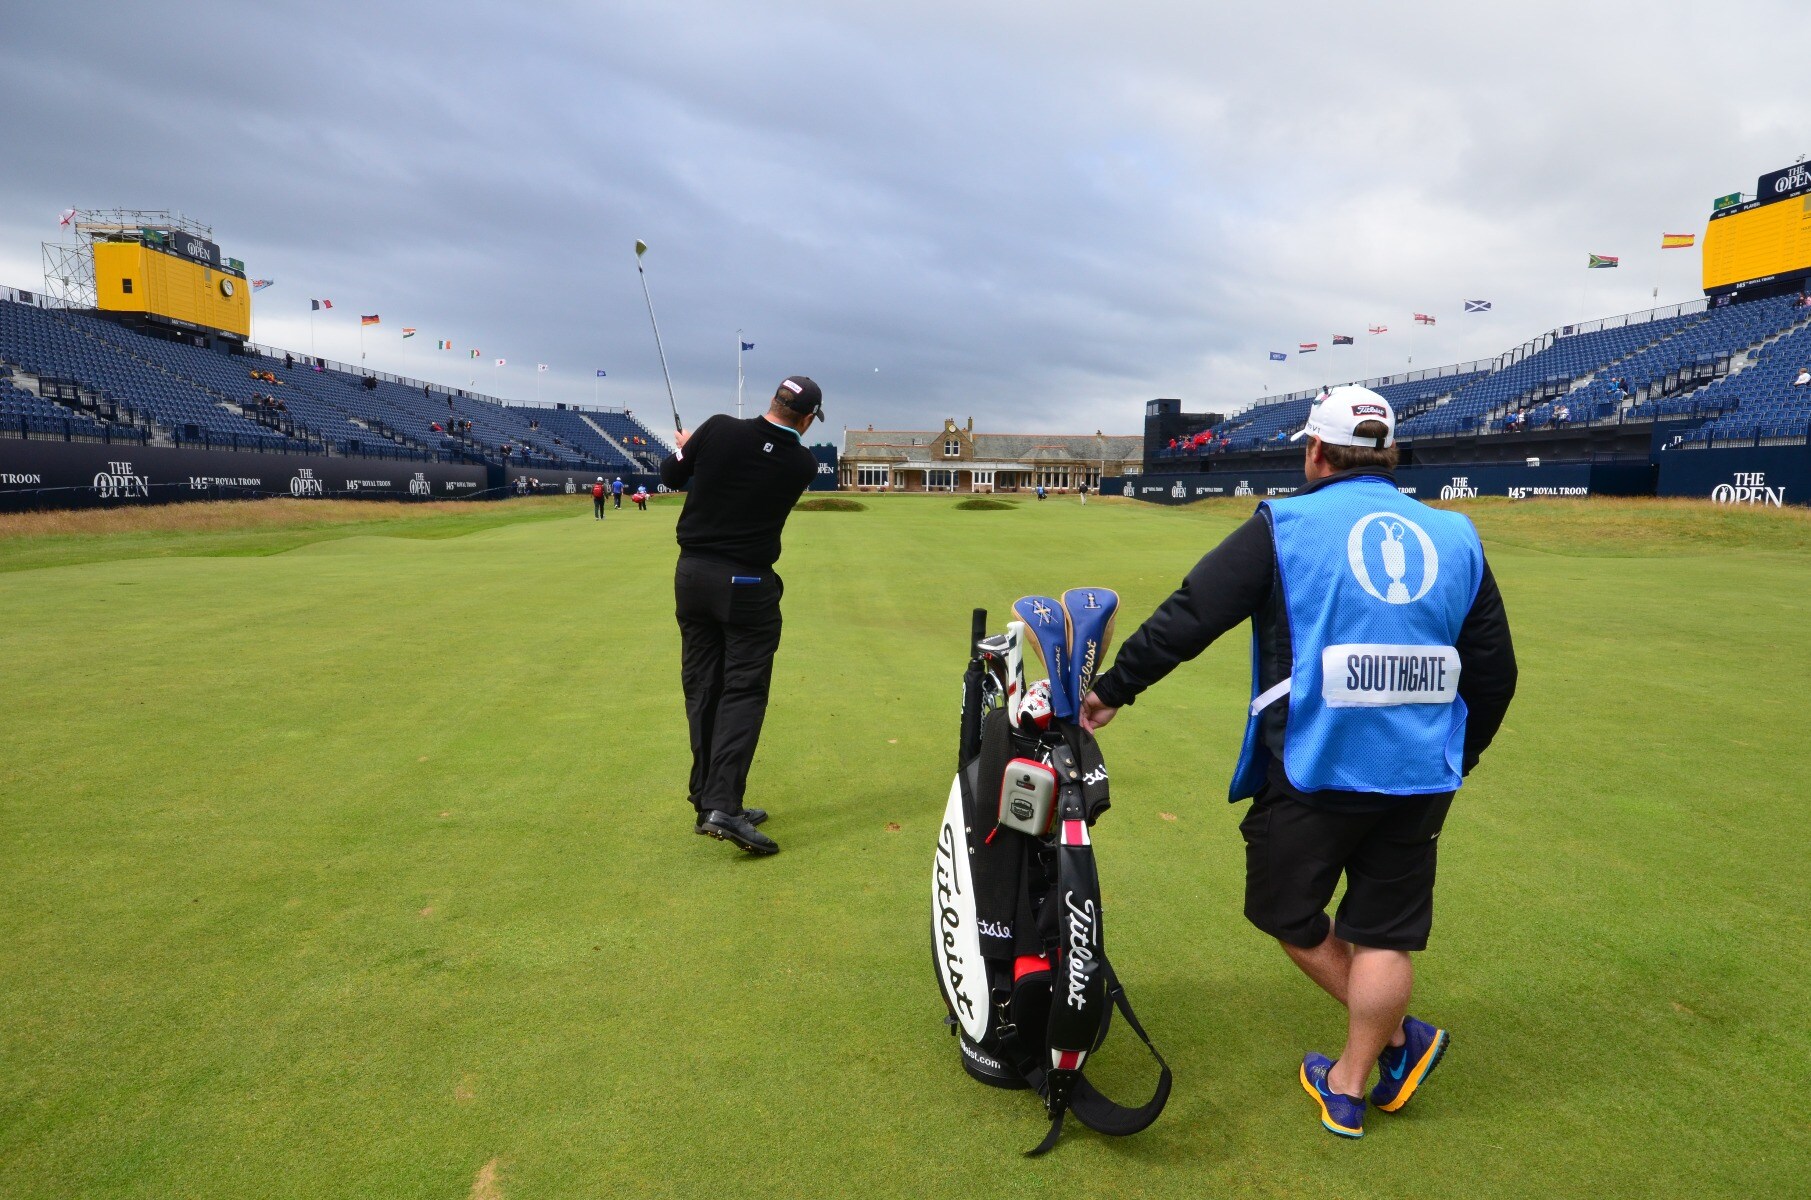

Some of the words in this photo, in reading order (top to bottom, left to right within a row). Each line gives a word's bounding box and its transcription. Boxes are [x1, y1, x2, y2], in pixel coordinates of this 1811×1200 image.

[1788, 165, 1805, 177] THE
[193, 238, 204, 248] THE
[187, 242, 211, 260] OPEN
[108, 461, 134, 475] THE
[298, 468, 314, 479] THE
[0, 473, 41, 484] TROON
[215, 477, 238, 486] ROYAL
[239, 477, 261, 486] TROON
[414, 472, 424, 480] THE
[1452, 477, 1468, 487] THE
[1733, 472, 1765, 486] THE
[93, 472, 149, 498] OPEN
[290, 476, 322, 497] OPEN
[409, 479, 430, 495] OPEN
[1240, 480, 1249, 488] THE
[1123, 486, 1135, 497] OPEN
[1171, 486, 1186, 498] OPEN
[1441, 485, 1478, 500] OPEN
[1533, 487, 1558, 495] ROYAL
[1559, 487, 1588, 495] TROON
[1711, 483, 1785, 509] OPEN
[1347, 654, 1446, 692] SOUTHGATE
[937, 822, 975, 1021] Titleist
[1065, 890, 1098, 1011] Titleist
